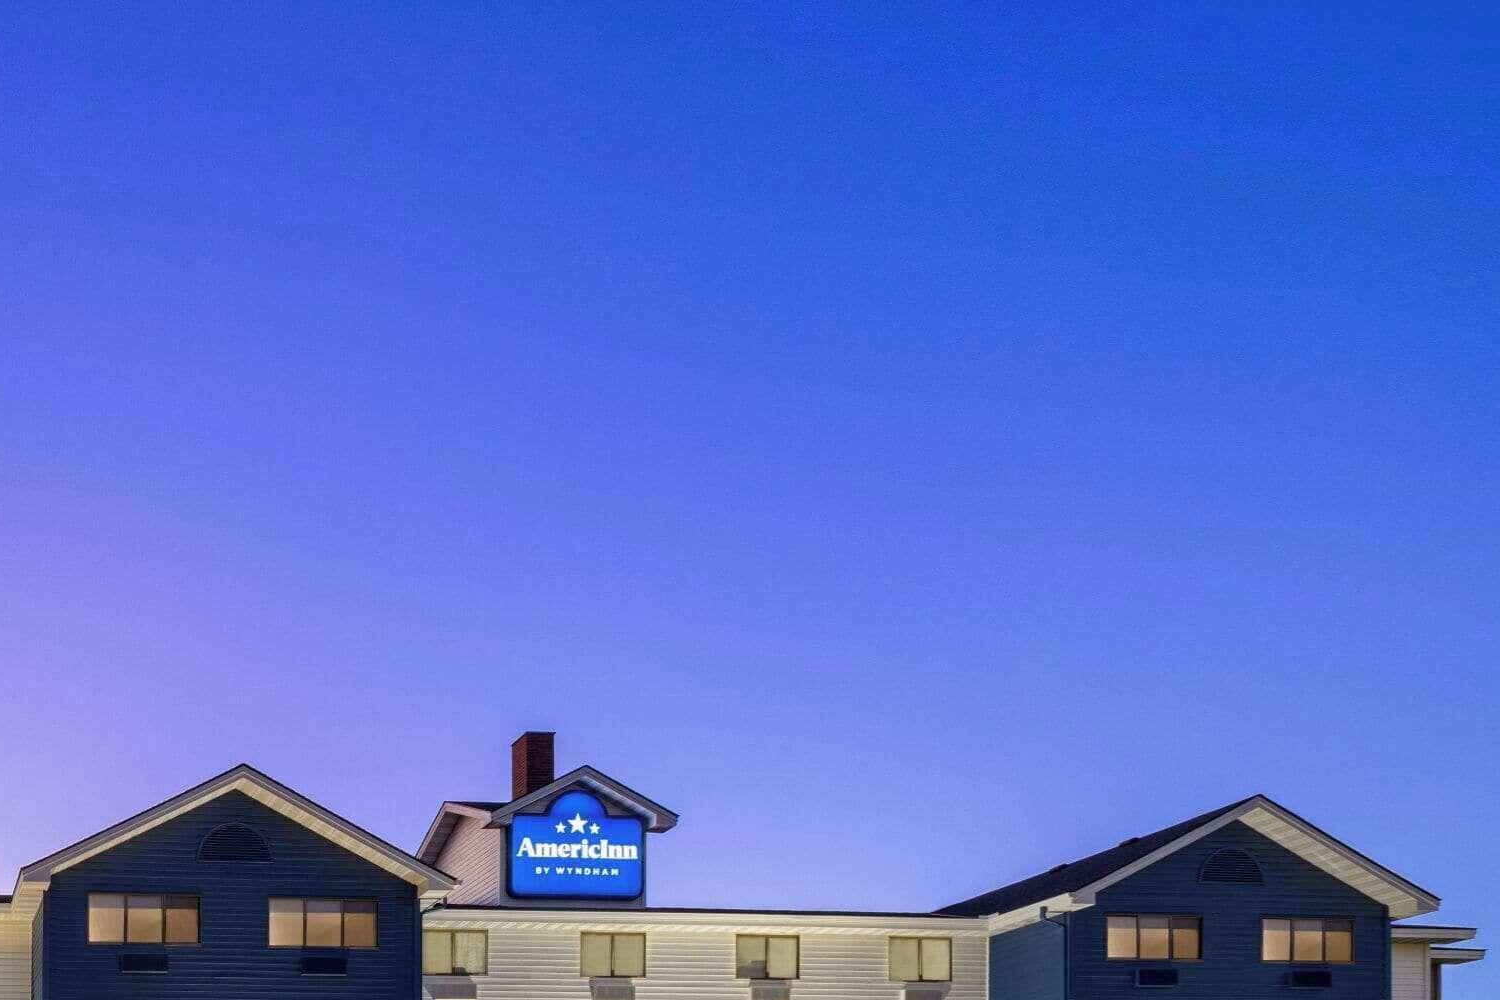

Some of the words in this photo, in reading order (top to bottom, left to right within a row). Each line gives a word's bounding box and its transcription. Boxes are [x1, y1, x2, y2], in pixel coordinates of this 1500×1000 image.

[516, 837, 638, 860] AmericInn
[535, 867, 550, 875] BY
[556, 867, 619, 876] WYNDHAM
